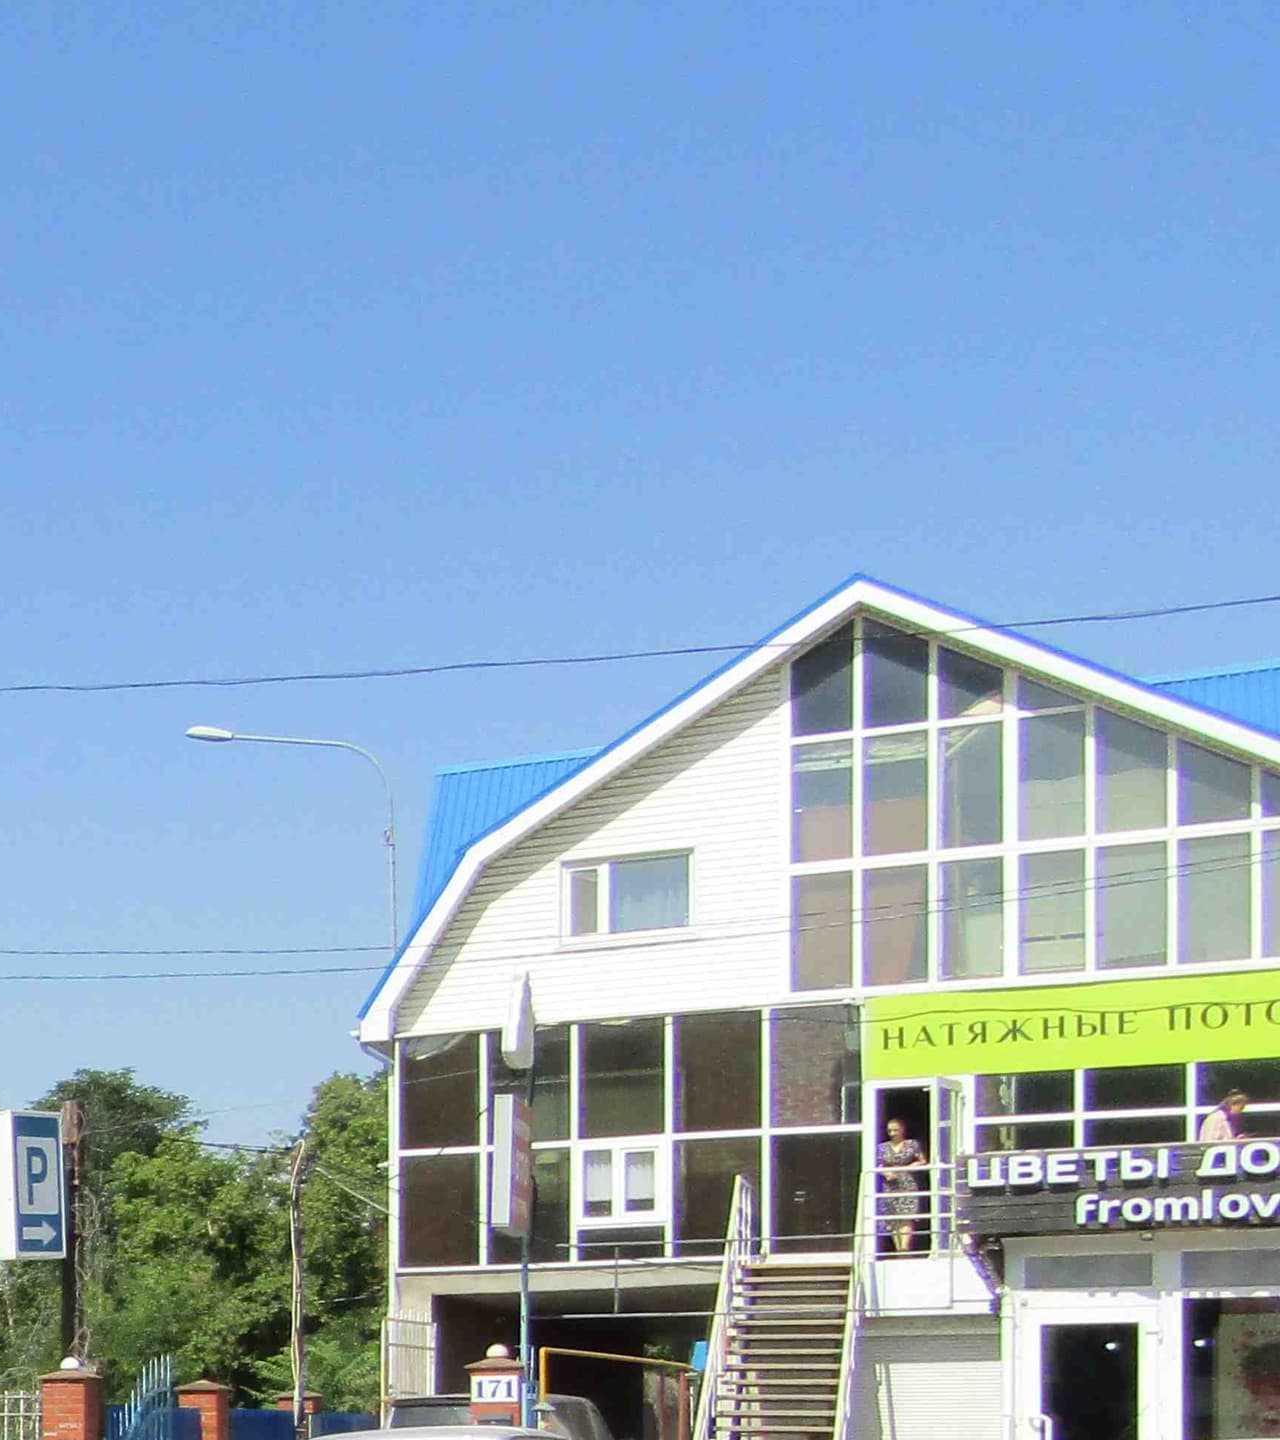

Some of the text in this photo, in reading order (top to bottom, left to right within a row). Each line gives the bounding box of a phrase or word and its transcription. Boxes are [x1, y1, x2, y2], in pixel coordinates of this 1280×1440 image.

[881, 1010, 1138, 1051] НАТЯЖНЫЕ
[26, 1146, 48, 1205] P
[967, 1149, 1169, 1189] ЦВЕТЫ
[476, 1380, 514, 1398] 171
